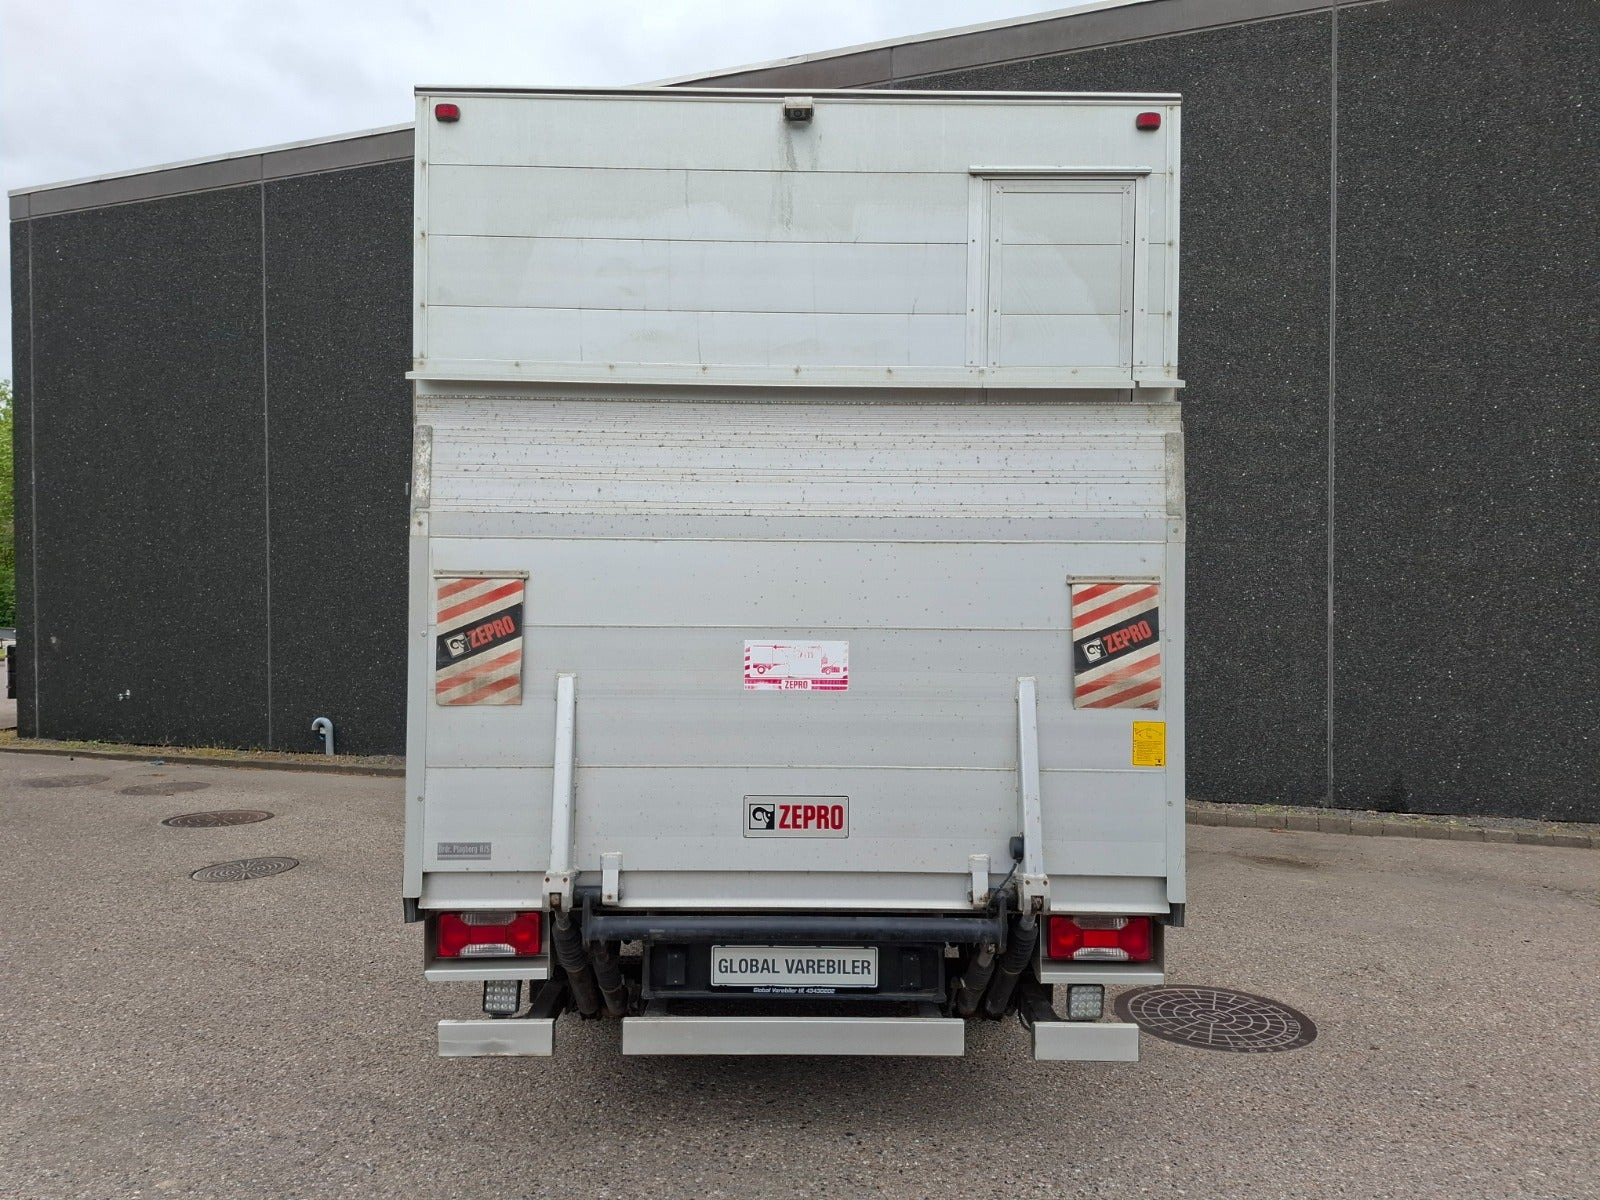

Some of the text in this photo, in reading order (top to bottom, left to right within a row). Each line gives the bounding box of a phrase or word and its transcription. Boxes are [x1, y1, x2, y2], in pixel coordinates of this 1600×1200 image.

[467, 615, 516, 648] ZEPRO
[1103, 620, 1153, 654] ZEPRO
[784, 680, 808, 689] ZEPRO
[778, 804, 844, 830] ZEPRO
[718, 958, 871, 975] GLOBAL VAREBILER
